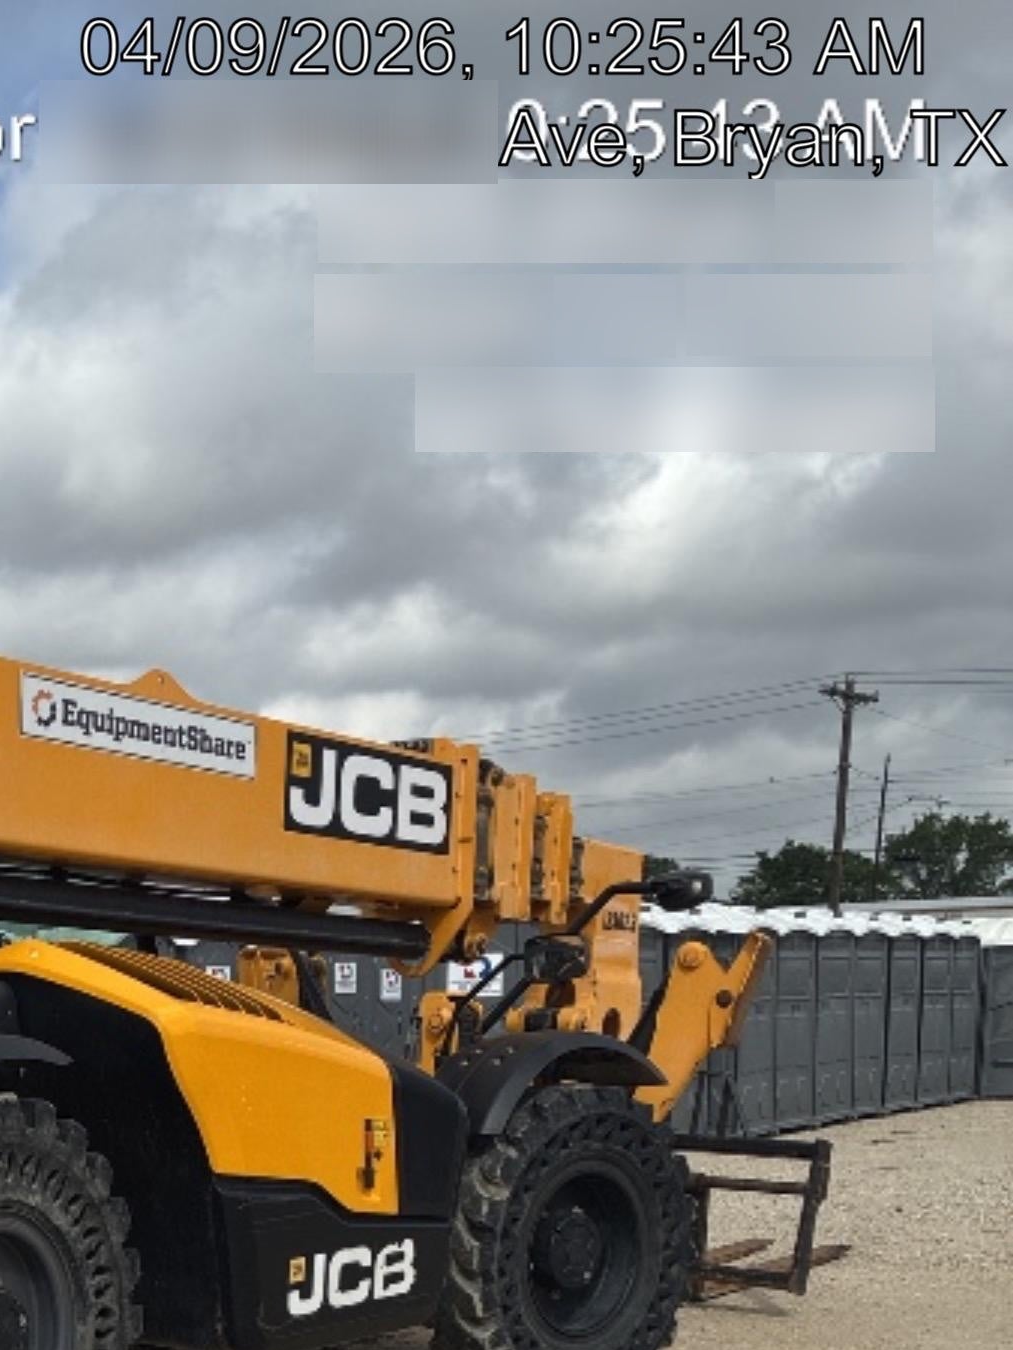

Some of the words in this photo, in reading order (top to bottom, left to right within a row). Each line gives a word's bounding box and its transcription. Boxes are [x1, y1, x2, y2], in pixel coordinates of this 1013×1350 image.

[61, 698, 246, 760] EquipmentShare
[289, 747, 447, 845] JCB
[287, 1238, 417, 1317] JCB
